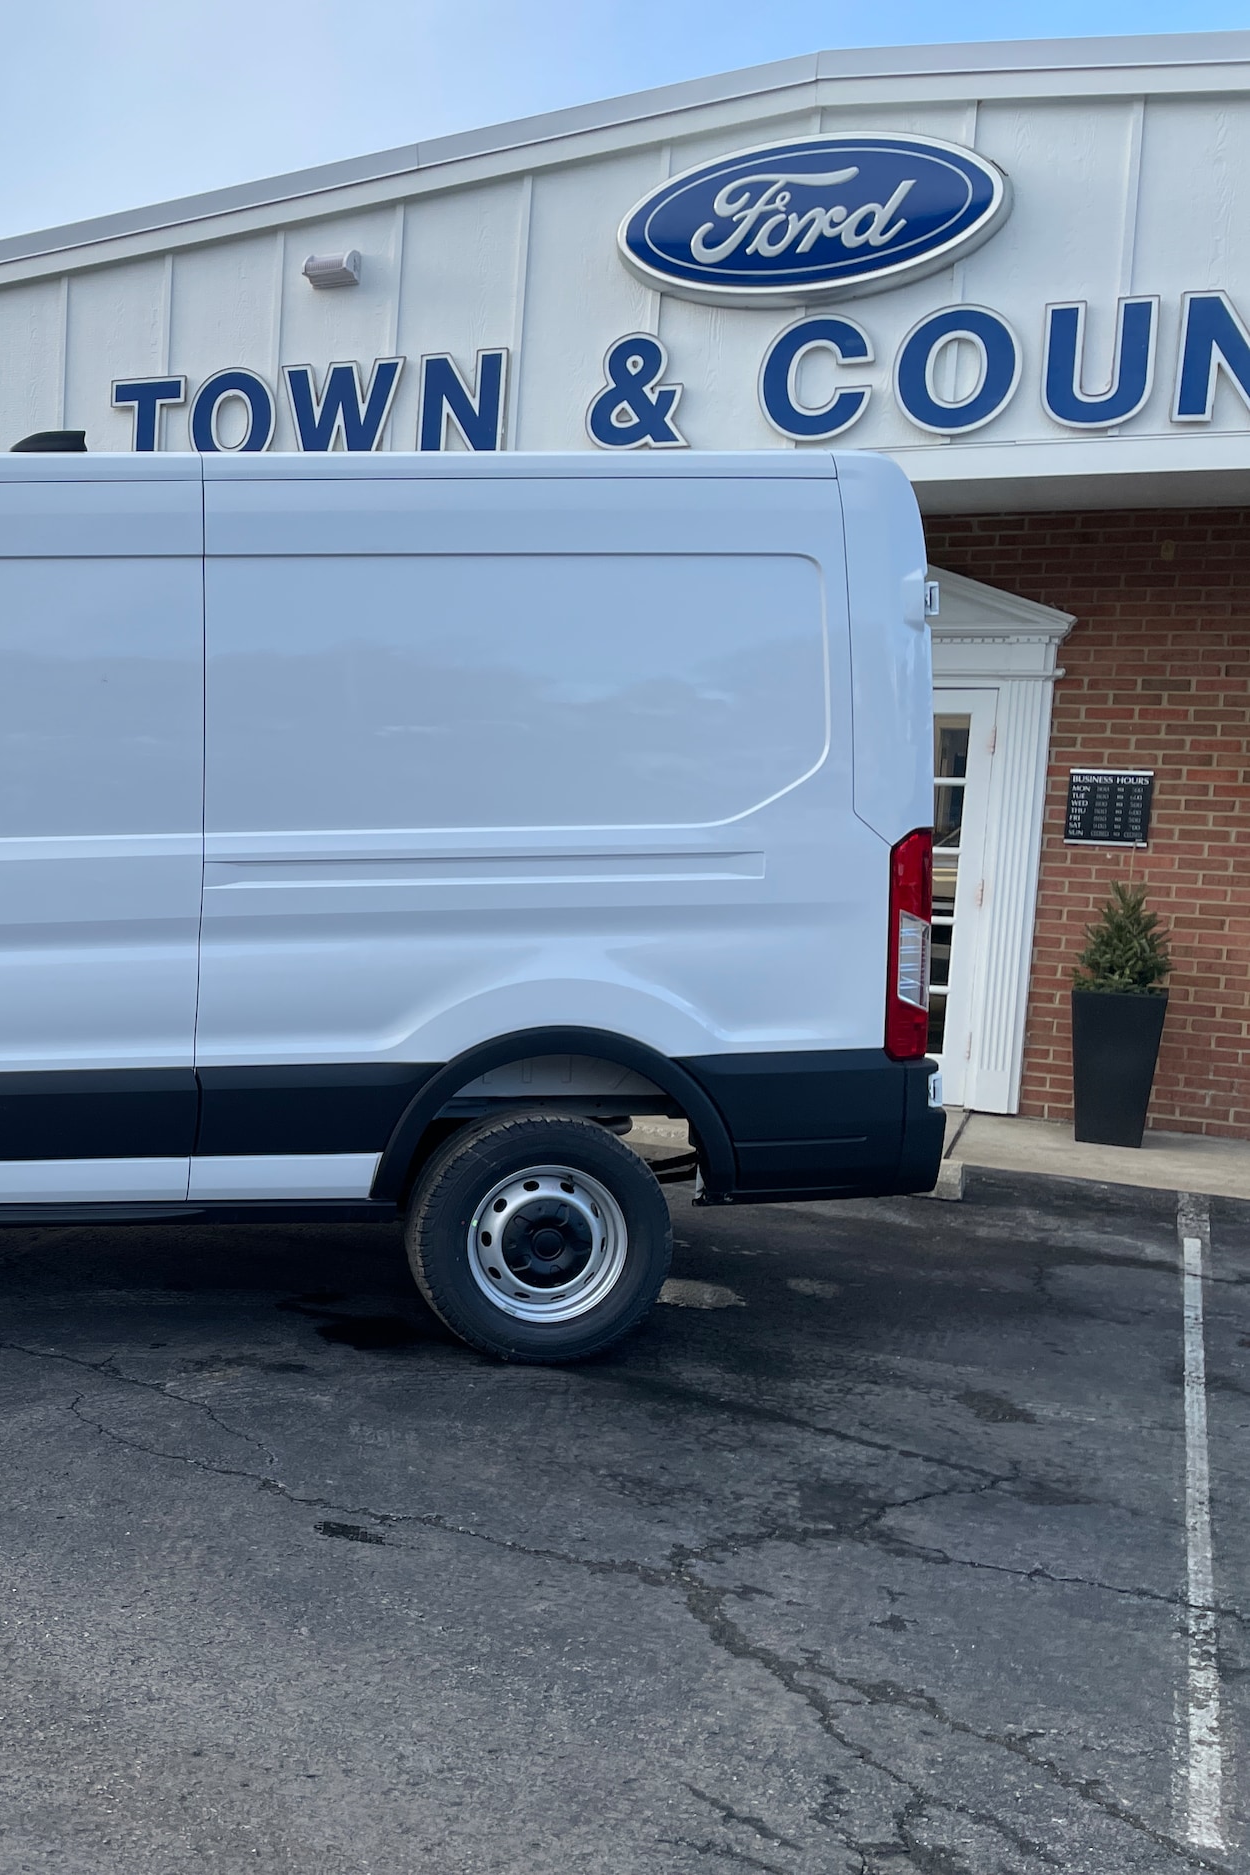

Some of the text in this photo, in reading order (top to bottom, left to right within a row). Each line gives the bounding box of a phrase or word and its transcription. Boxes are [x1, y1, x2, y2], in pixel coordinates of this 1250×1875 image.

[690, 166, 917, 265] Ford
[110, 347, 510, 451] TOWN
[585, 331, 690, 450] &
[1072, 775, 1150, 785] BUSINESS HOURS
